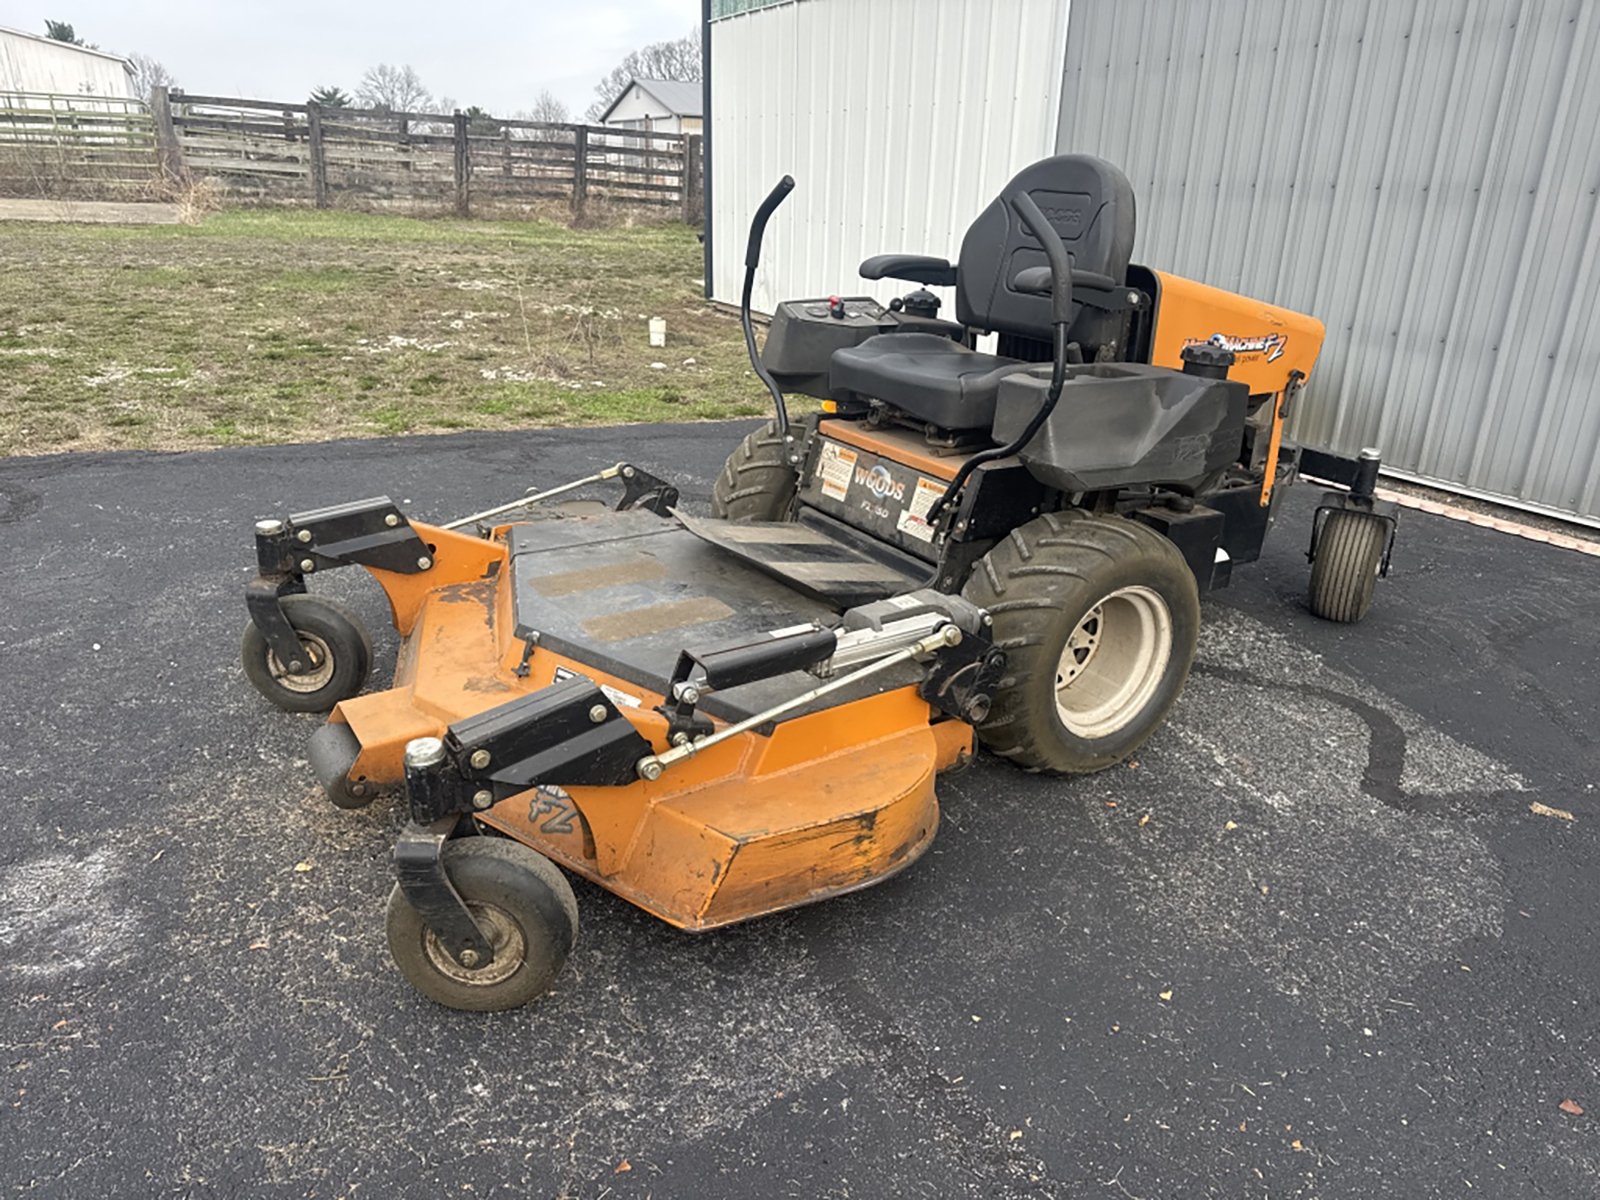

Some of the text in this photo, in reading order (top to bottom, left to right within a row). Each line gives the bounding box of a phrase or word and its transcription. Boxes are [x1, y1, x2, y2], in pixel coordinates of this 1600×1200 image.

[1040, 206, 1082, 225] OODS
[1262, 332, 1288, 364] FZ
[854, 466, 906, 501] WOODS
[528, 789, 578, 834] FZ
